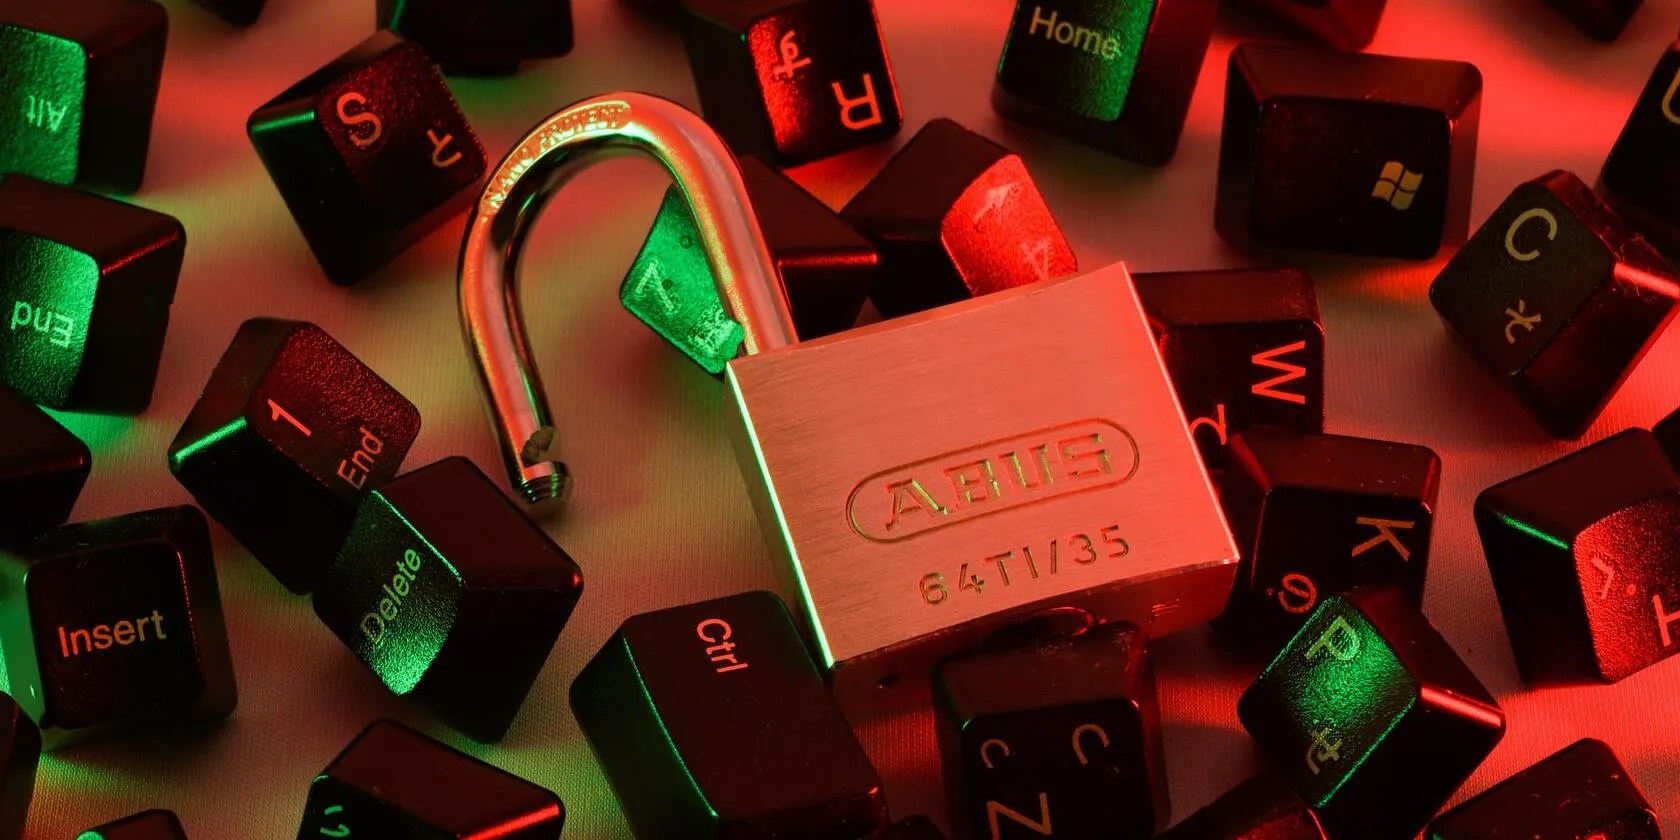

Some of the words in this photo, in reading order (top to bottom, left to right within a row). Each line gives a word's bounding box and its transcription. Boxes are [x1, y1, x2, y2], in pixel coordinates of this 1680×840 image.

[776, 30, 812, 81] す
[1029, 6, 1122, 61] Home
[27, 95, 67, 132] Alt
[336, 91, 382, 147] S
[832, 73, 882, 131] R
[426, 128, 462, 168] と
[1505, 208, 1558, 262] C
[10, 300, 75, 349] End
[1505, 299, 1542, 344] そ
[1252, 340, 1306, 405] W
[266, 398, 312, 438] 1
[337, 425, 385, 490] End
[884, 432, 1114, 532] ABUS
[918, 523, 1131, 606] 64TI/35
[1352, 516, 1416, 562] K
[359, 546, 422, 645] Delete
[1278, 573, 1317, 614] の
[57, 609, 167, 658] Insert
[696, 618, 748, 674] Ctrl
[1304, 615, 1361, 663] P
